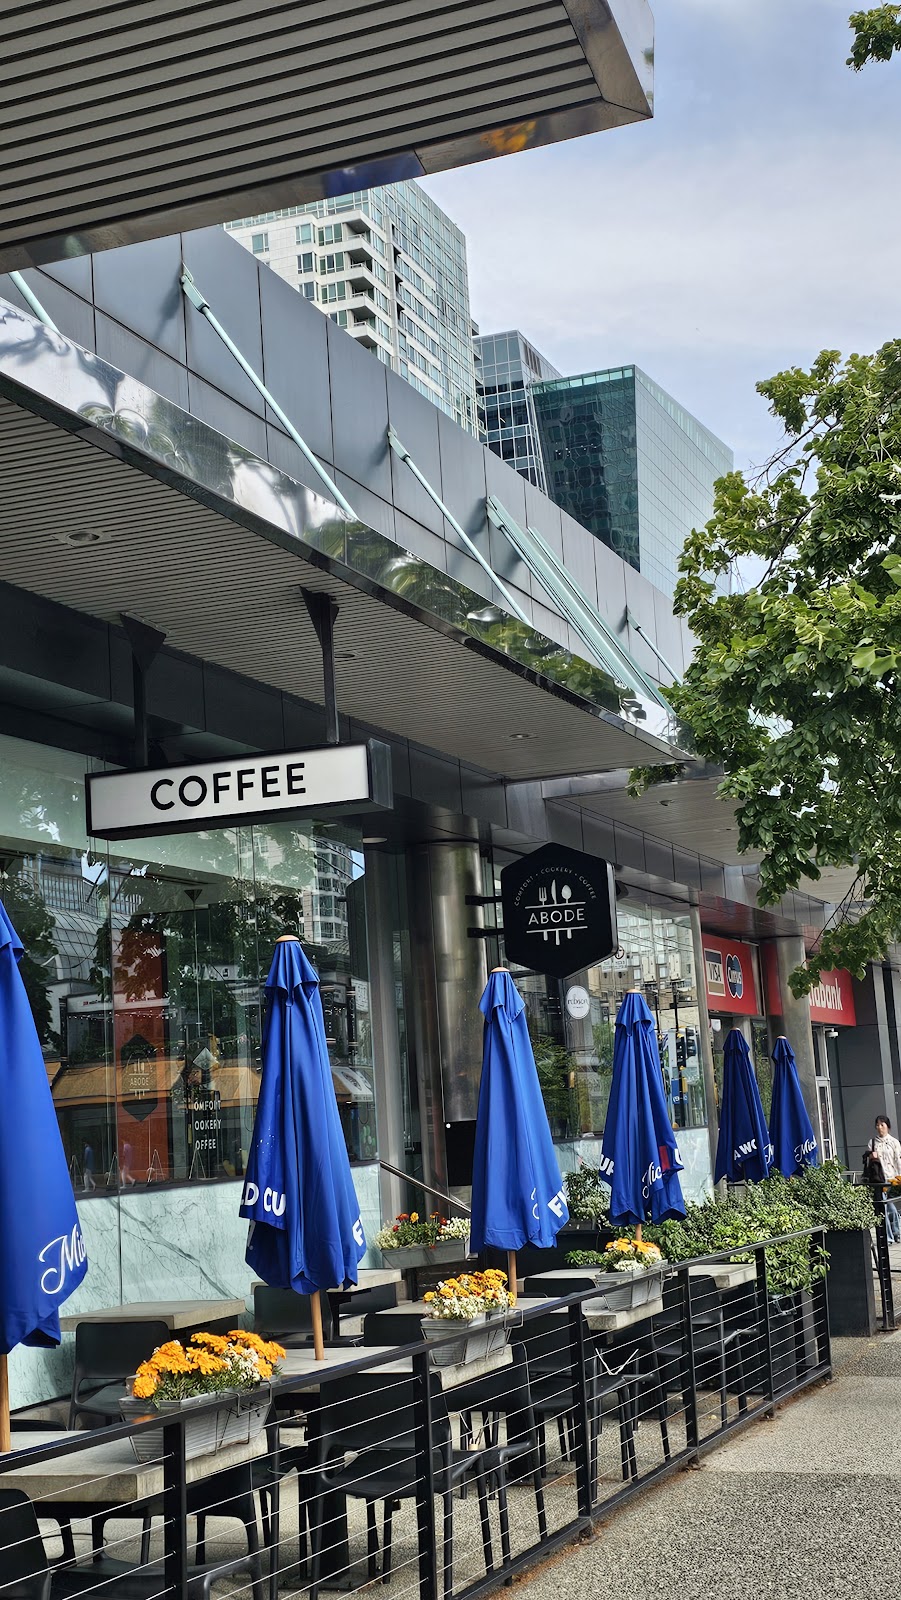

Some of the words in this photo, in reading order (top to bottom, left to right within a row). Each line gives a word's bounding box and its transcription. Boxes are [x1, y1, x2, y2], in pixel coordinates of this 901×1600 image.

[150, 762, 306, 811] COFFEE
[514, 875, 534, 906] COMFORT
[540, 866, 573, 875] COOKERY
[578, 875, 597, 900] COFFEE
[528, 908, 585, 926] ABODE
[708, 962, 722, 982] VISA
[809, 977, 843, 1011] iabank
